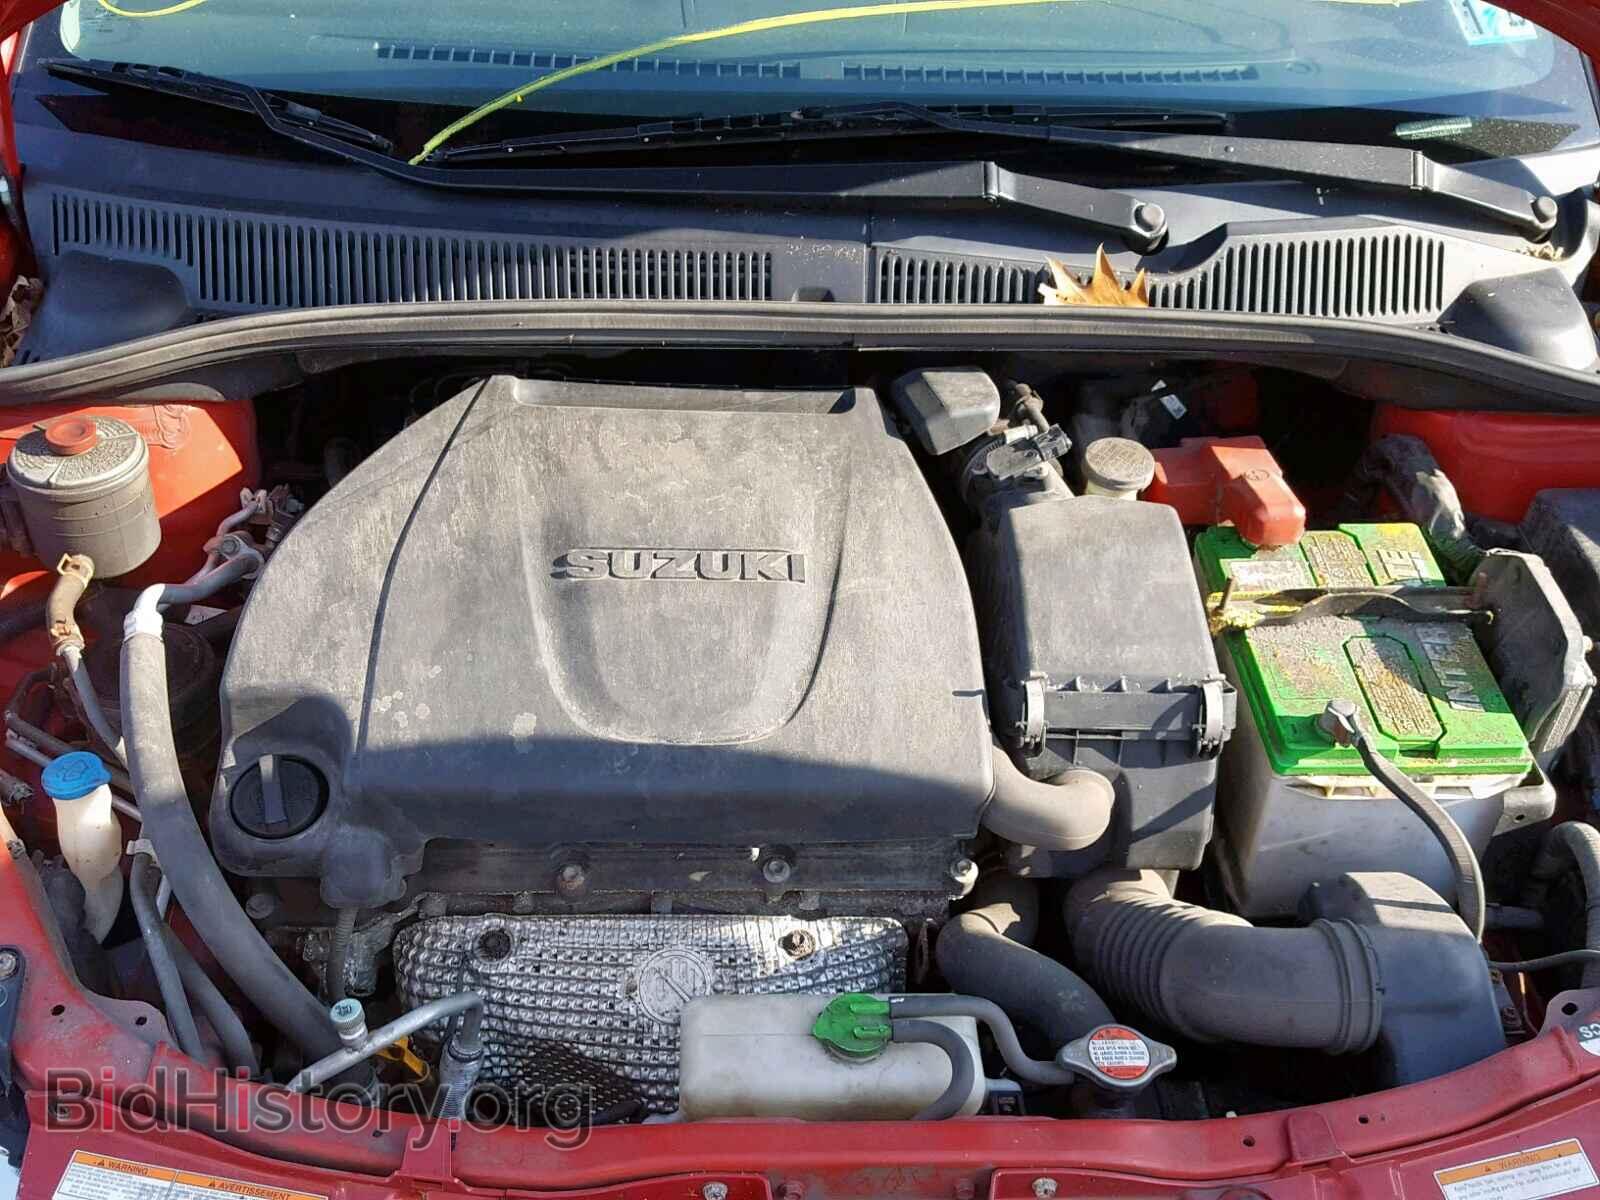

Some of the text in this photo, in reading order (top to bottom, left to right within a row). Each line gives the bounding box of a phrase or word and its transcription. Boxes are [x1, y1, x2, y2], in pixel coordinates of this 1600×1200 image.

[550, 548, 805, 583] SUZUKI
[108, 1160, 149, 1176] WARNING
[217, 1181, 291, 1200] AVERTISSEMENT
